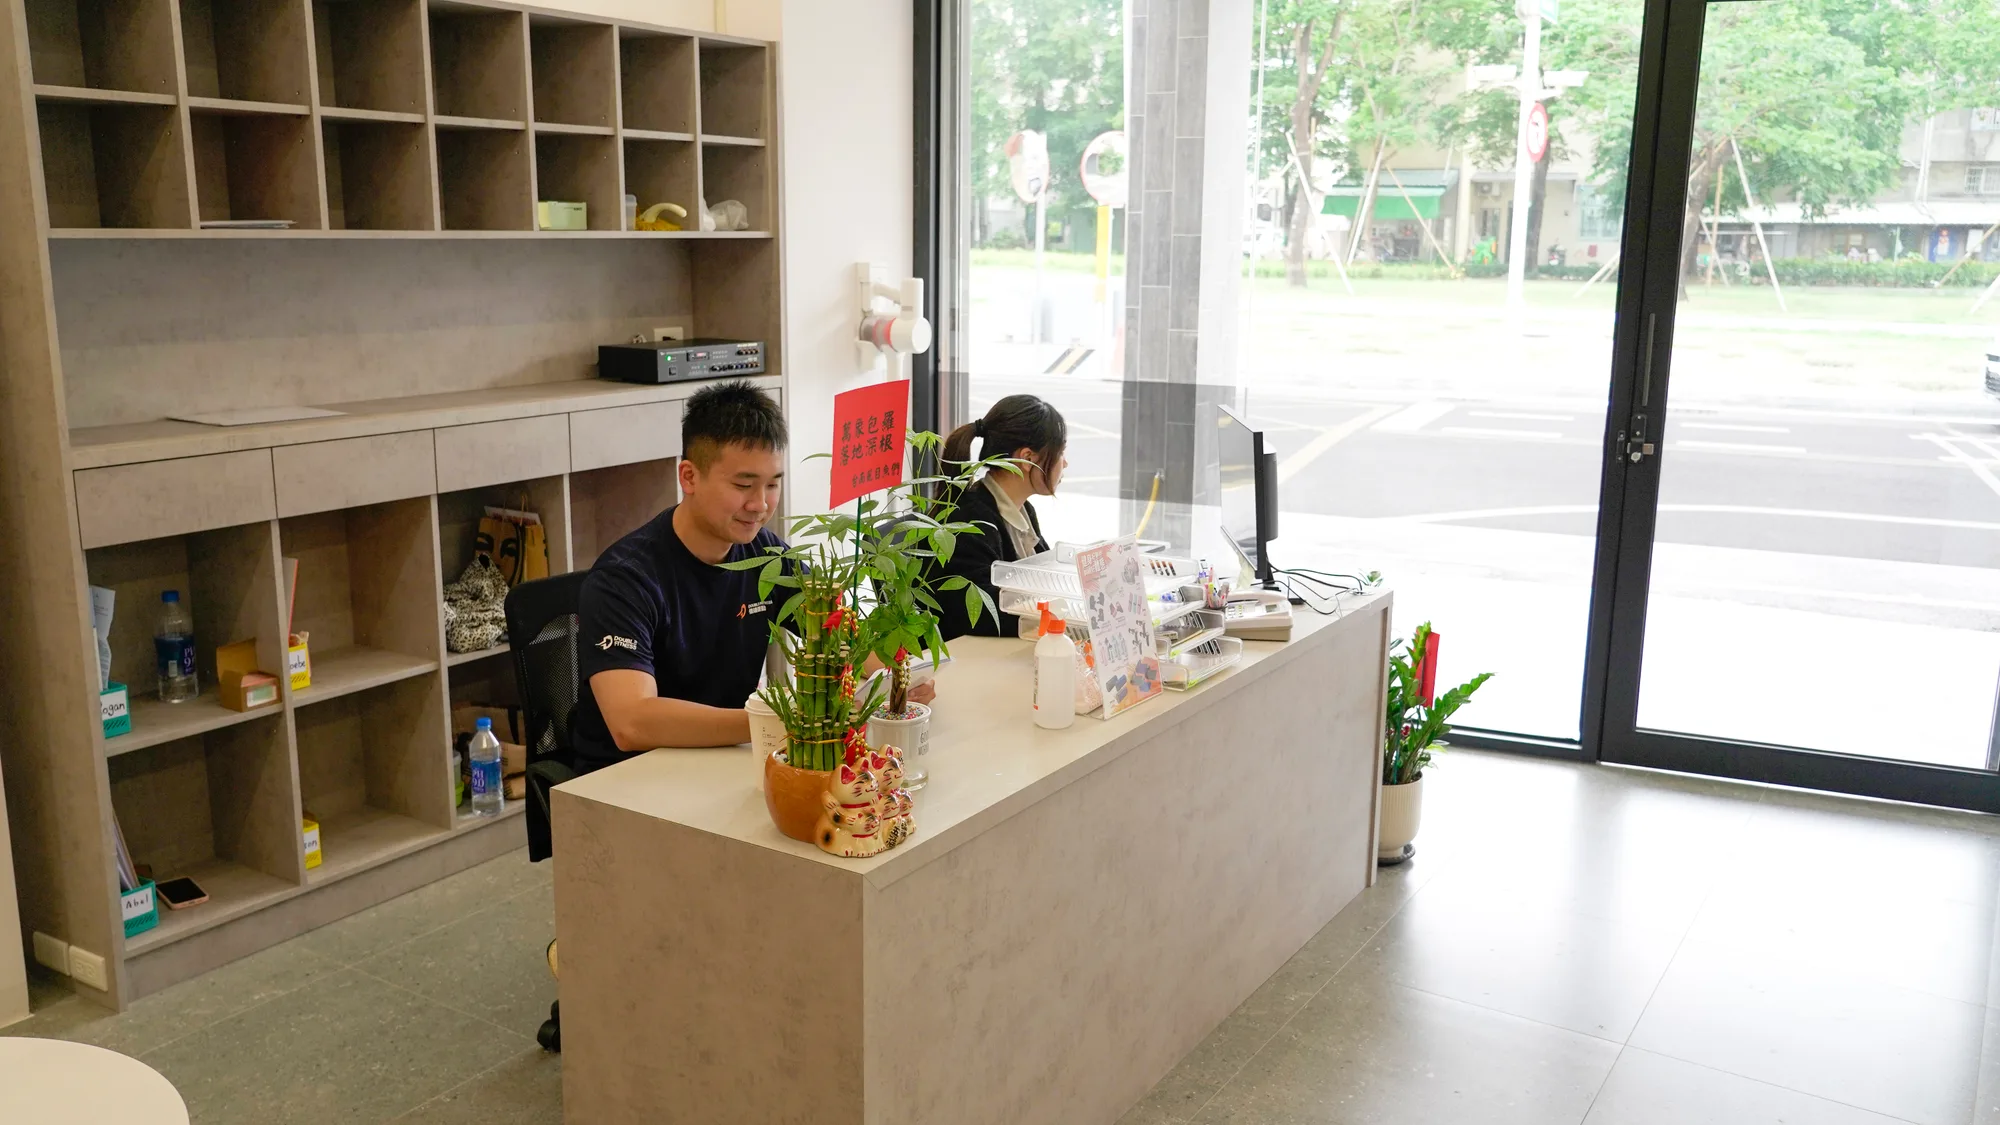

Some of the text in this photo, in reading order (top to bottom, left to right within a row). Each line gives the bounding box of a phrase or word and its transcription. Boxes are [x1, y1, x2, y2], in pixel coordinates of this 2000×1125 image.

[841, 410, 895, 443] 萬象包羅
[840, 433, 893, 467] 落地深根
[614, 641, 637, 650] FITNESS
[100, 700, 126, 716] ogan
